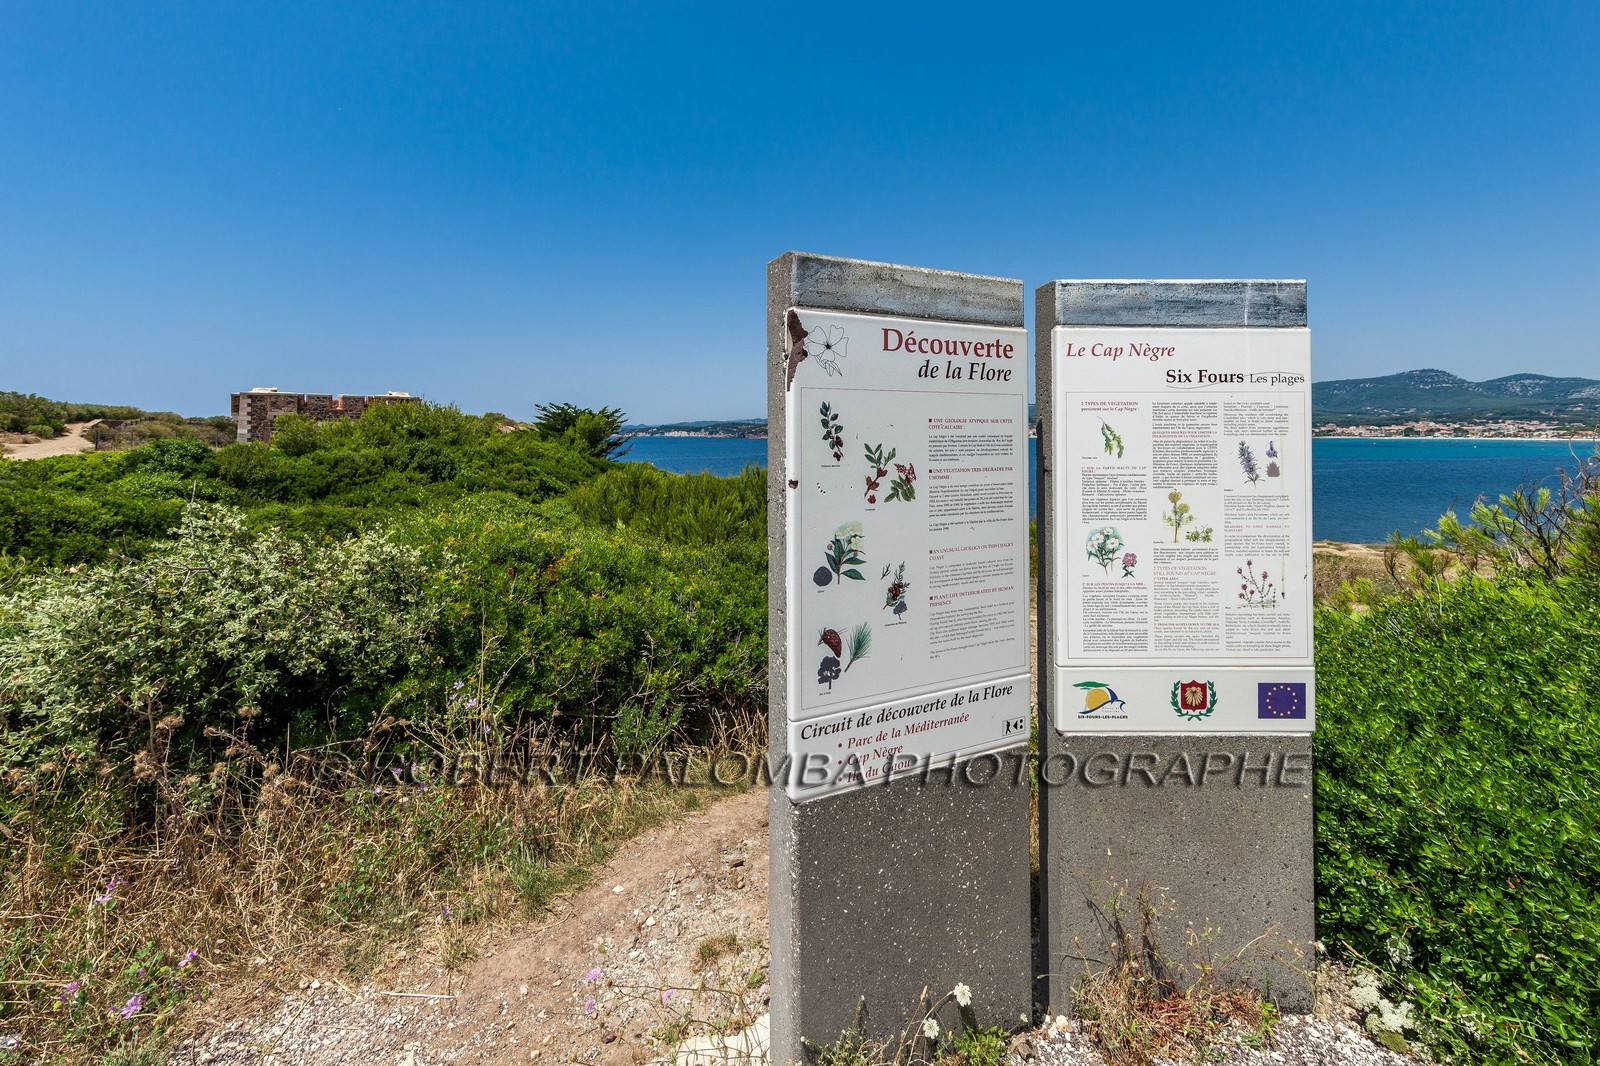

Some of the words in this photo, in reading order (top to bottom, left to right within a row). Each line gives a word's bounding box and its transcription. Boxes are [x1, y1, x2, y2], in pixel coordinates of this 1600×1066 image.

[882, 328, 1014, 359] Découverte
[1066, 343, 1086, 357] Le
[1091, 343, 1124, 361] Cap
[1128, 343, 1176, 362] Nègre
[918, 360, 938, 379] de
[946, 360, 962, 379] la
[968, 362, 1012, 382] Flore
[1166, 369, 1192, 383] Six
[1198, 370, 1244, 383] Fours
[1250, 373, 1268, 383] Les
[1270, 374, 1305, 386] plages
[801, 716, 853, 740] Circuit
[856, 712, 872, 728] de
[876, 698, 947, 724] découverte
[950, 692, 965, 707] de
[968, 688, 980, 703] la
[983, 684, 1013, 701] Flore
[847, 735, 873, 749] Parc
[875, 730, 888, 742] de
[891, 727, 902, 738] la
[904, 712, 970, 735] Méditerranée
[847, 752, 870, 766] Cap
[873, 744, 903, 760] Nègre
[865, 765, 879, 778] du
[882, 759, 911, 773] Gaou
